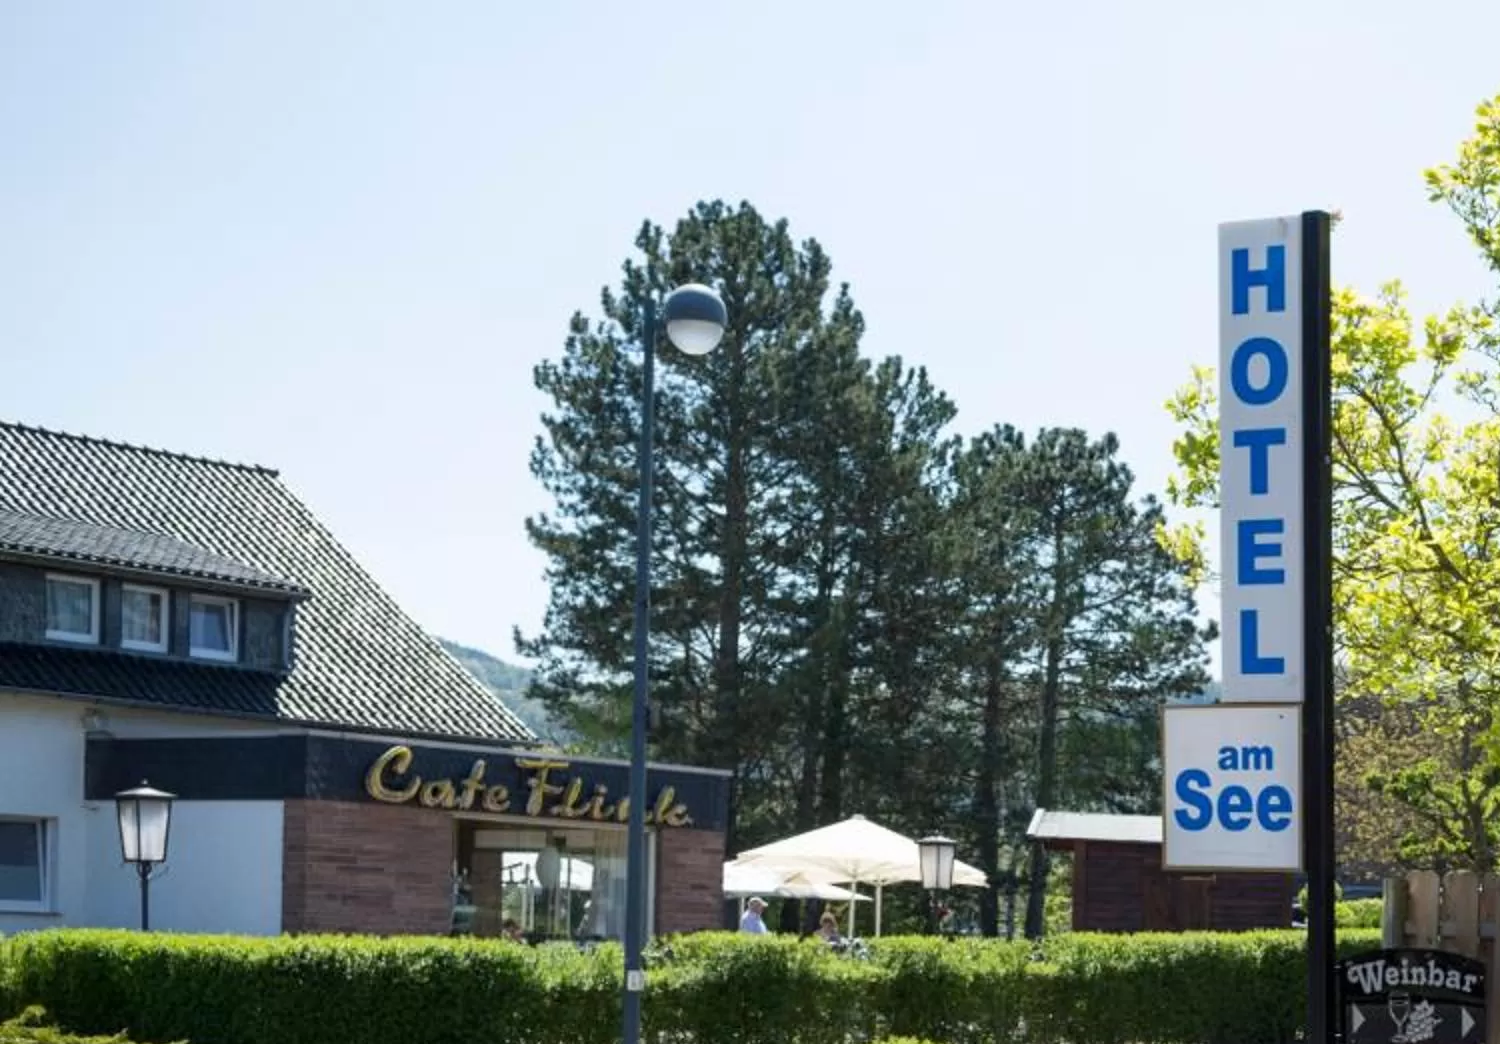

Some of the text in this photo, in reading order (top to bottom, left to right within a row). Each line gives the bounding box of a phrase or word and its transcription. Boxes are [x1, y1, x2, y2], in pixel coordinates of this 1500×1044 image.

[1230, 245, 1288, 676] HOTEL
[1218, 745, 1273, 771] am
[1173, 768, 1293, 832] See
[1347, 957, 1478, 994] Weinbar
